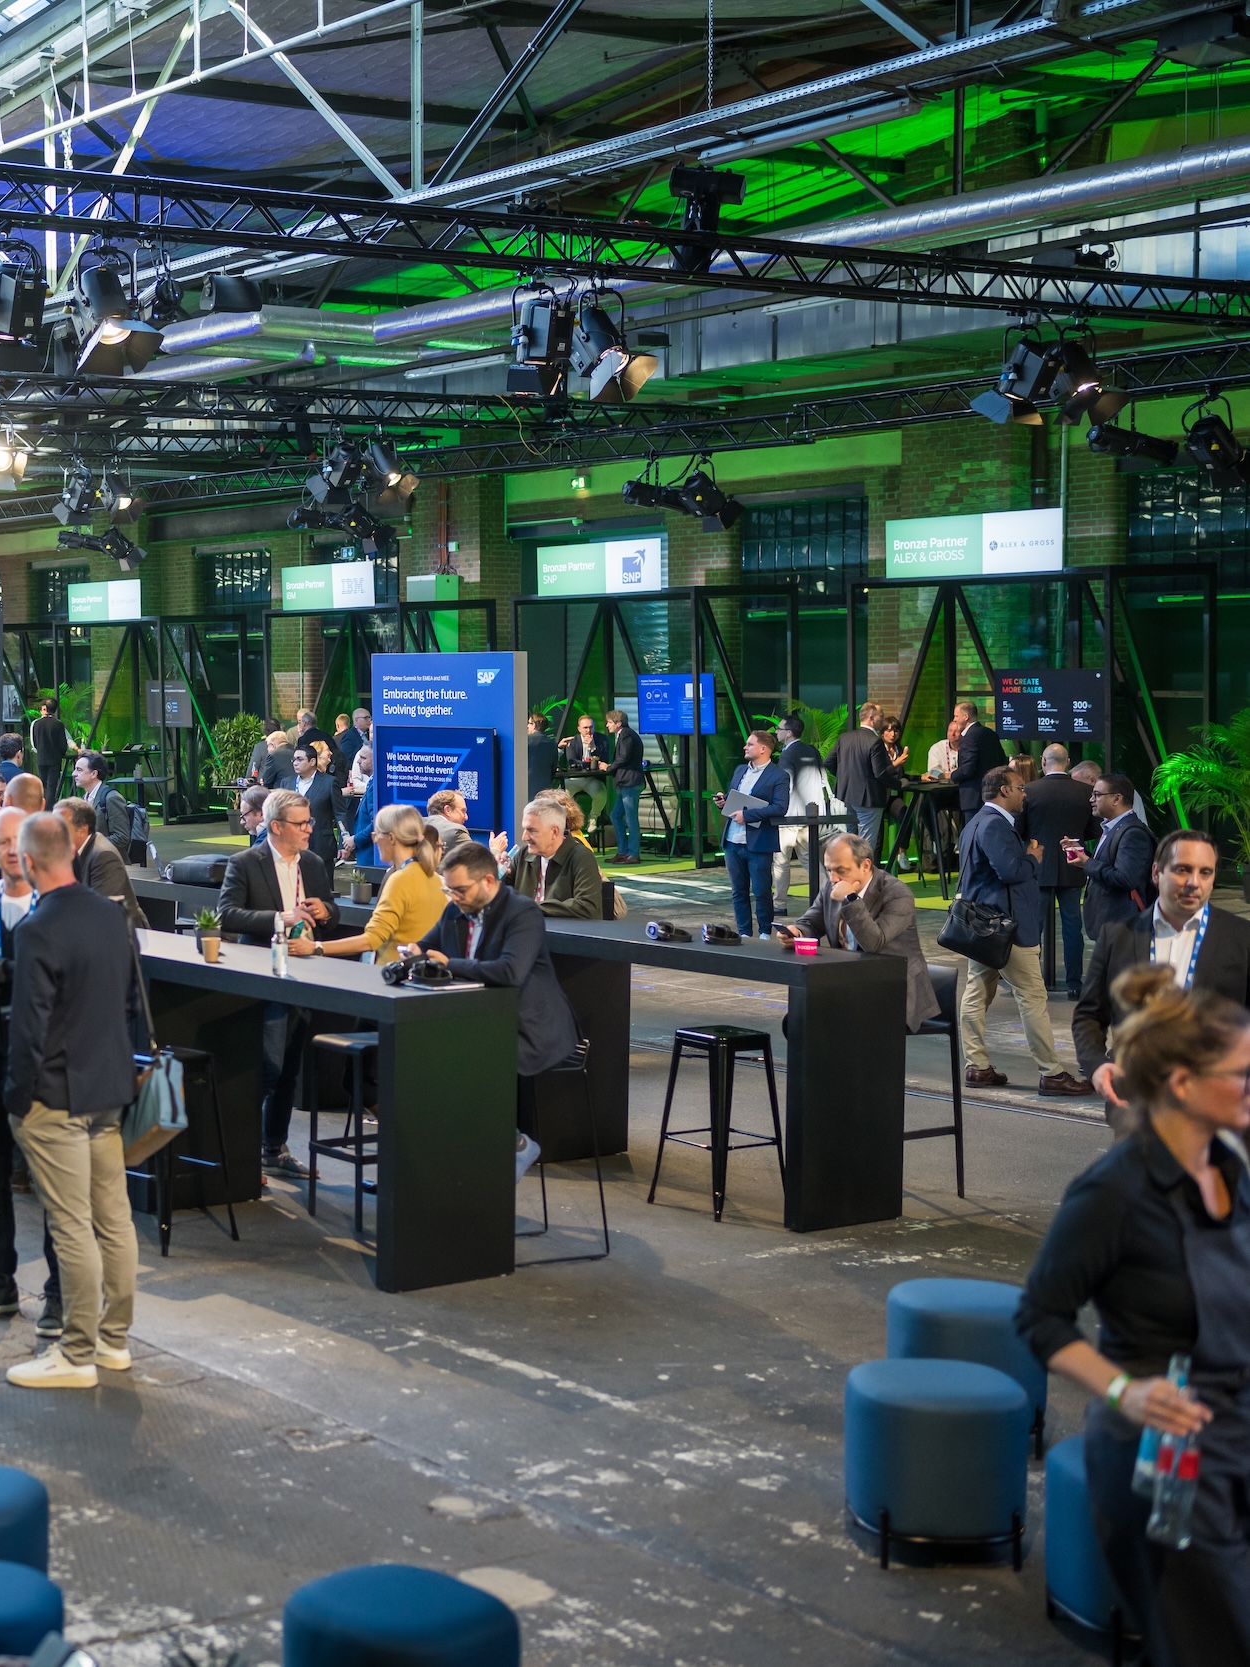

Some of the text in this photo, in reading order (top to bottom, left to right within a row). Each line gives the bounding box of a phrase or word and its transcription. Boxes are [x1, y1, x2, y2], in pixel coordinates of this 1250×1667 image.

[893, 537, 968, 550] Bronze Partner
[1029, 539, 1055, 547] GROSS
[893, 550, 965, 564] ALEX & GROSS
[542, 561, 595, 573] Bronze Partner
[543, 575, 557, 584] SNP
[622, 571, 641, 583] SNP
[286, 580, 325, 590] Bronze Partner
[341, 578, 365, 595] IBM
[286, 592, 296, 600] IBM
[477, 672, 495, 684] SAP
[383, 688, 468, 702] Embracing the future.
[1003, 701, 1008, 709] 5
[1037, 700, 1047, 709] 25
[1072, 701, 1088, 709] 300
[383, 704, 453, 718] Evolving together.
[1002, 717, 1012, 725] 25
[1038, 717, 1055, 726] 120+
[1073, 718, 1083, 726] 25
[386, 752, 458, 765] We look forward to your
[387, 764, 415, 773] feedback
[424, 765, 434, 774] the
[435, 767, 455, 775] event.
